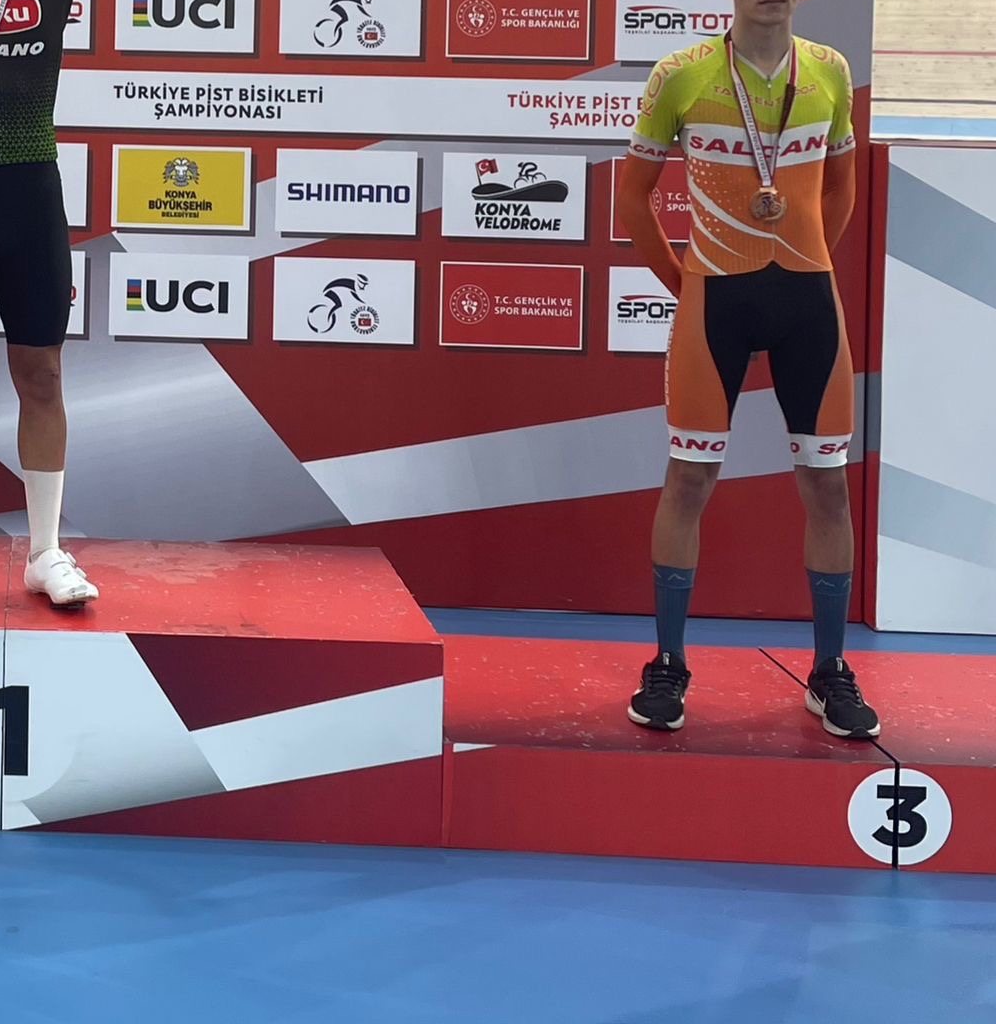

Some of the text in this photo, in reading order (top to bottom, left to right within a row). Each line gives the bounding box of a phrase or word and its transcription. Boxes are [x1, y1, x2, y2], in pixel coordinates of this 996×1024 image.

[522, 7, 565, 19] GENÇLİK
[566, 9, 580, 18] VE
[624, 13, 733, 30] SPORTOT
[501, 18, 580, 28] SPOR BAKANLIĞI
[113, 82, 323, 103] TÜRKİYE PİST BİSİKLETİ
[508, 91, 586, 109] TÜRKİYE
[593, 92, 631, 110] PİST
[154, 102, 282, 119] ŞAMPİYONASI
[549, 110, 636, 129] ŞAMPİYO
[690, 134, 827, 158] SALCAN
[165, 190, 197, 199] KONYA
[288, 182, 410, 204] SHIMANO
[148, 198, 213, 212] BÜYÜKŞEHİR
[475, 203, 531, 217] KONYA
[475, 217, 561, 231] VELODROME
[146, 279, 229, 314] UCI
[515, 295, 557, 306] GENÇLİK
[560, 298, 573, 306] VE
[494, 306, 573, 317] SPOR BAKANLIĞI
[872, 784, 927, 848] 3
